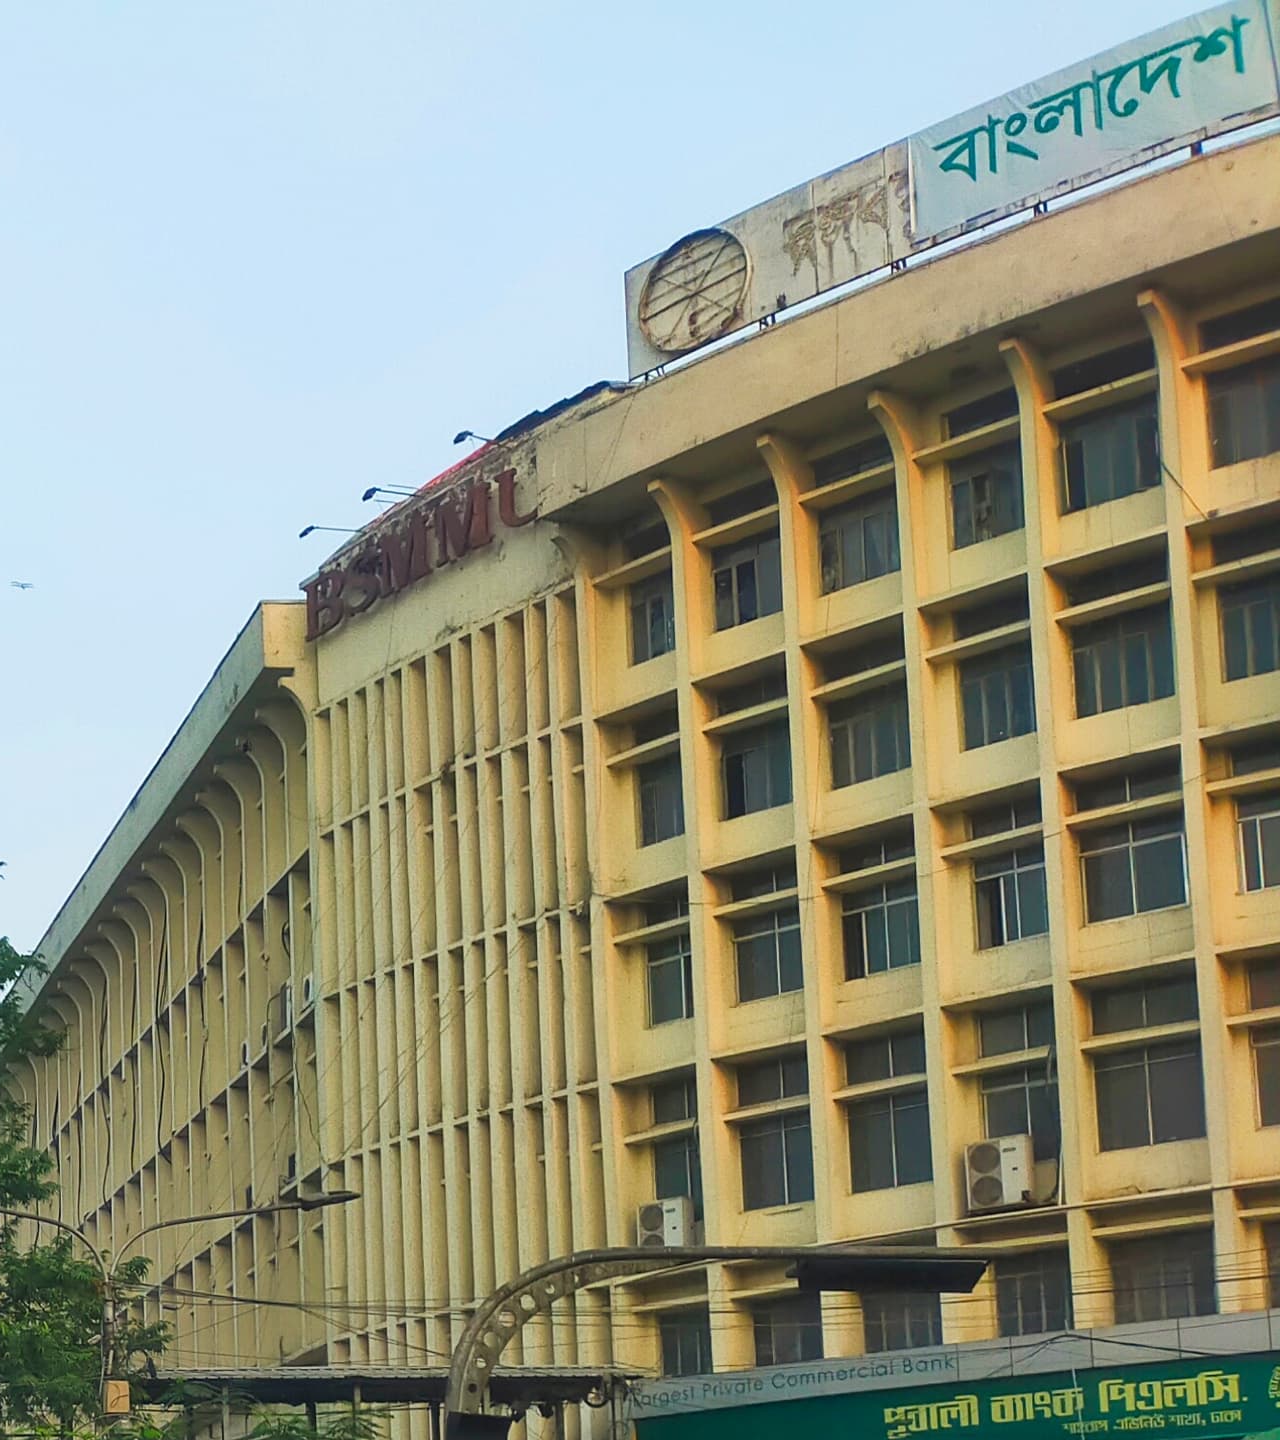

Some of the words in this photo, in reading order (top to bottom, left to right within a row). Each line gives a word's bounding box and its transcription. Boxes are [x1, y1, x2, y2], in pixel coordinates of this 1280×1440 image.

[933, 15, 1250, 182] বাংলাদেশ
[633, 1384, 695, 1408] Largest
[703, 1377, 764, 1399] Private
[772, 1361, 894, 1390] Commercial
[902, 1353, 955, 1374] Bank
[990, 1387, 1085, 1424] ব্যাংক
